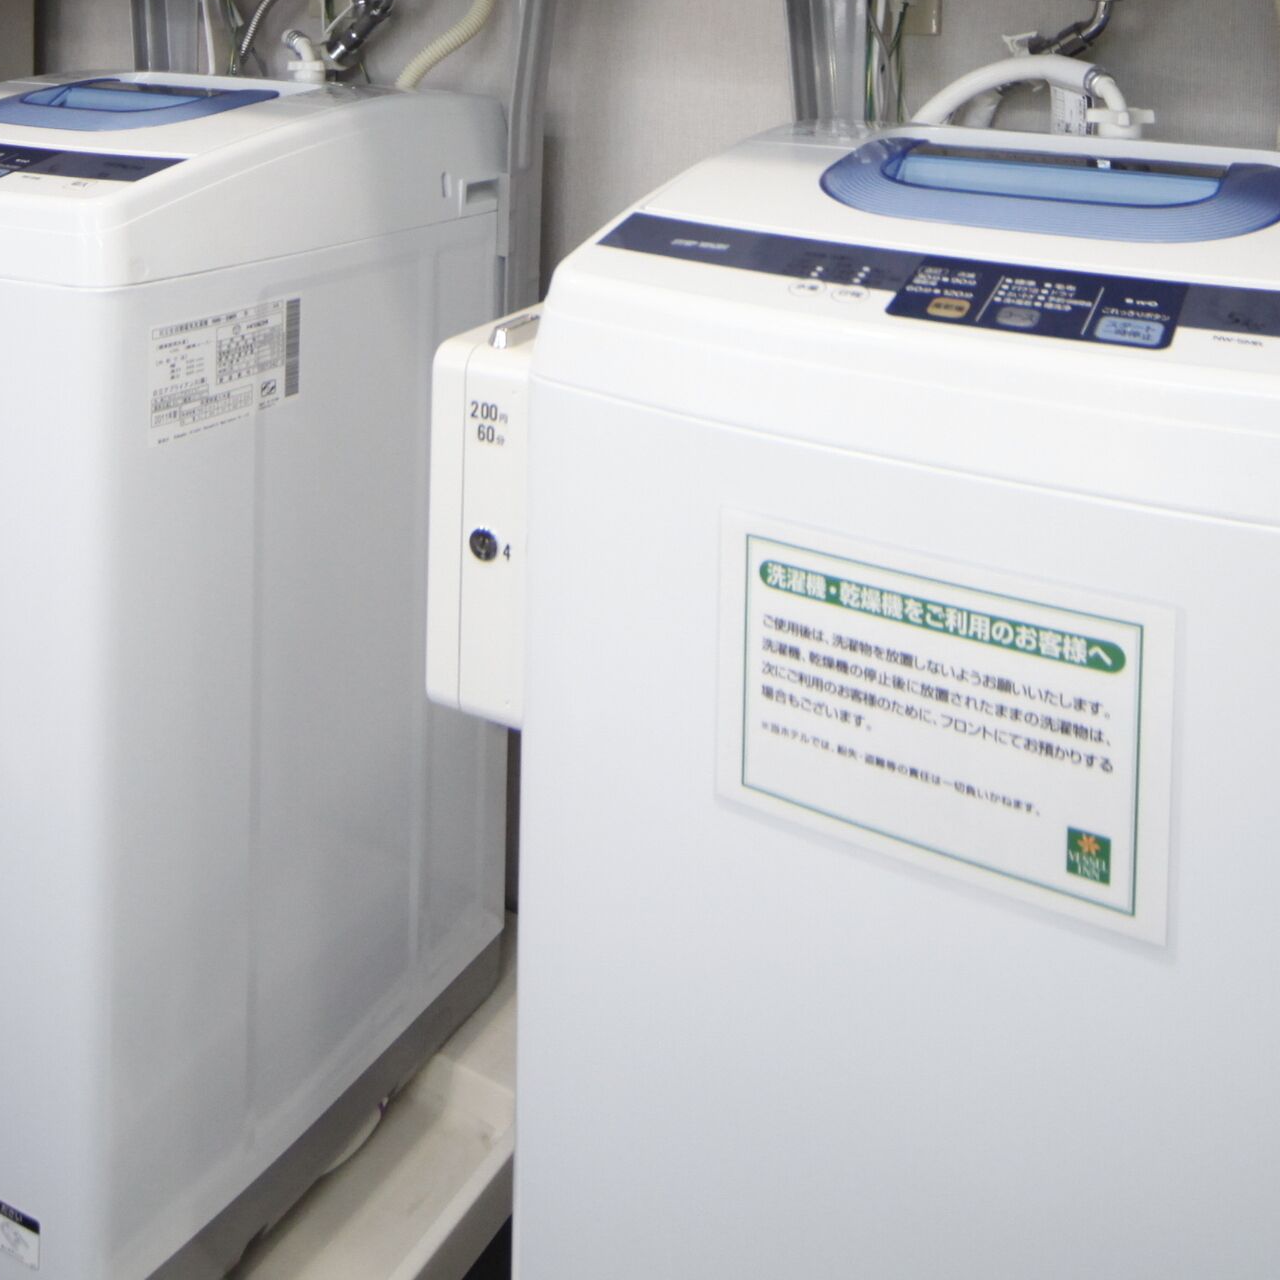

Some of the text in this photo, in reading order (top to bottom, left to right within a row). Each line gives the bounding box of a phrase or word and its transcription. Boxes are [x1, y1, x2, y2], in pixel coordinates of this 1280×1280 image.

[762, 613, 1111, 719] ご使用後は、洗濯物を放置しないようお願いいたします。
[766, 562, 1114, 669] 洗濯機・乾燥機をご利用のお客様へ
[761, 684, 872, 731] 場合もございます。
[761, 660, 1114, 774] 次にご利用のお客様のために、フロントにてお預かりする
[762, 637, 1111, 747] 洗濯機、乾燥機の停止後に放置されたままの洗濯物は、
